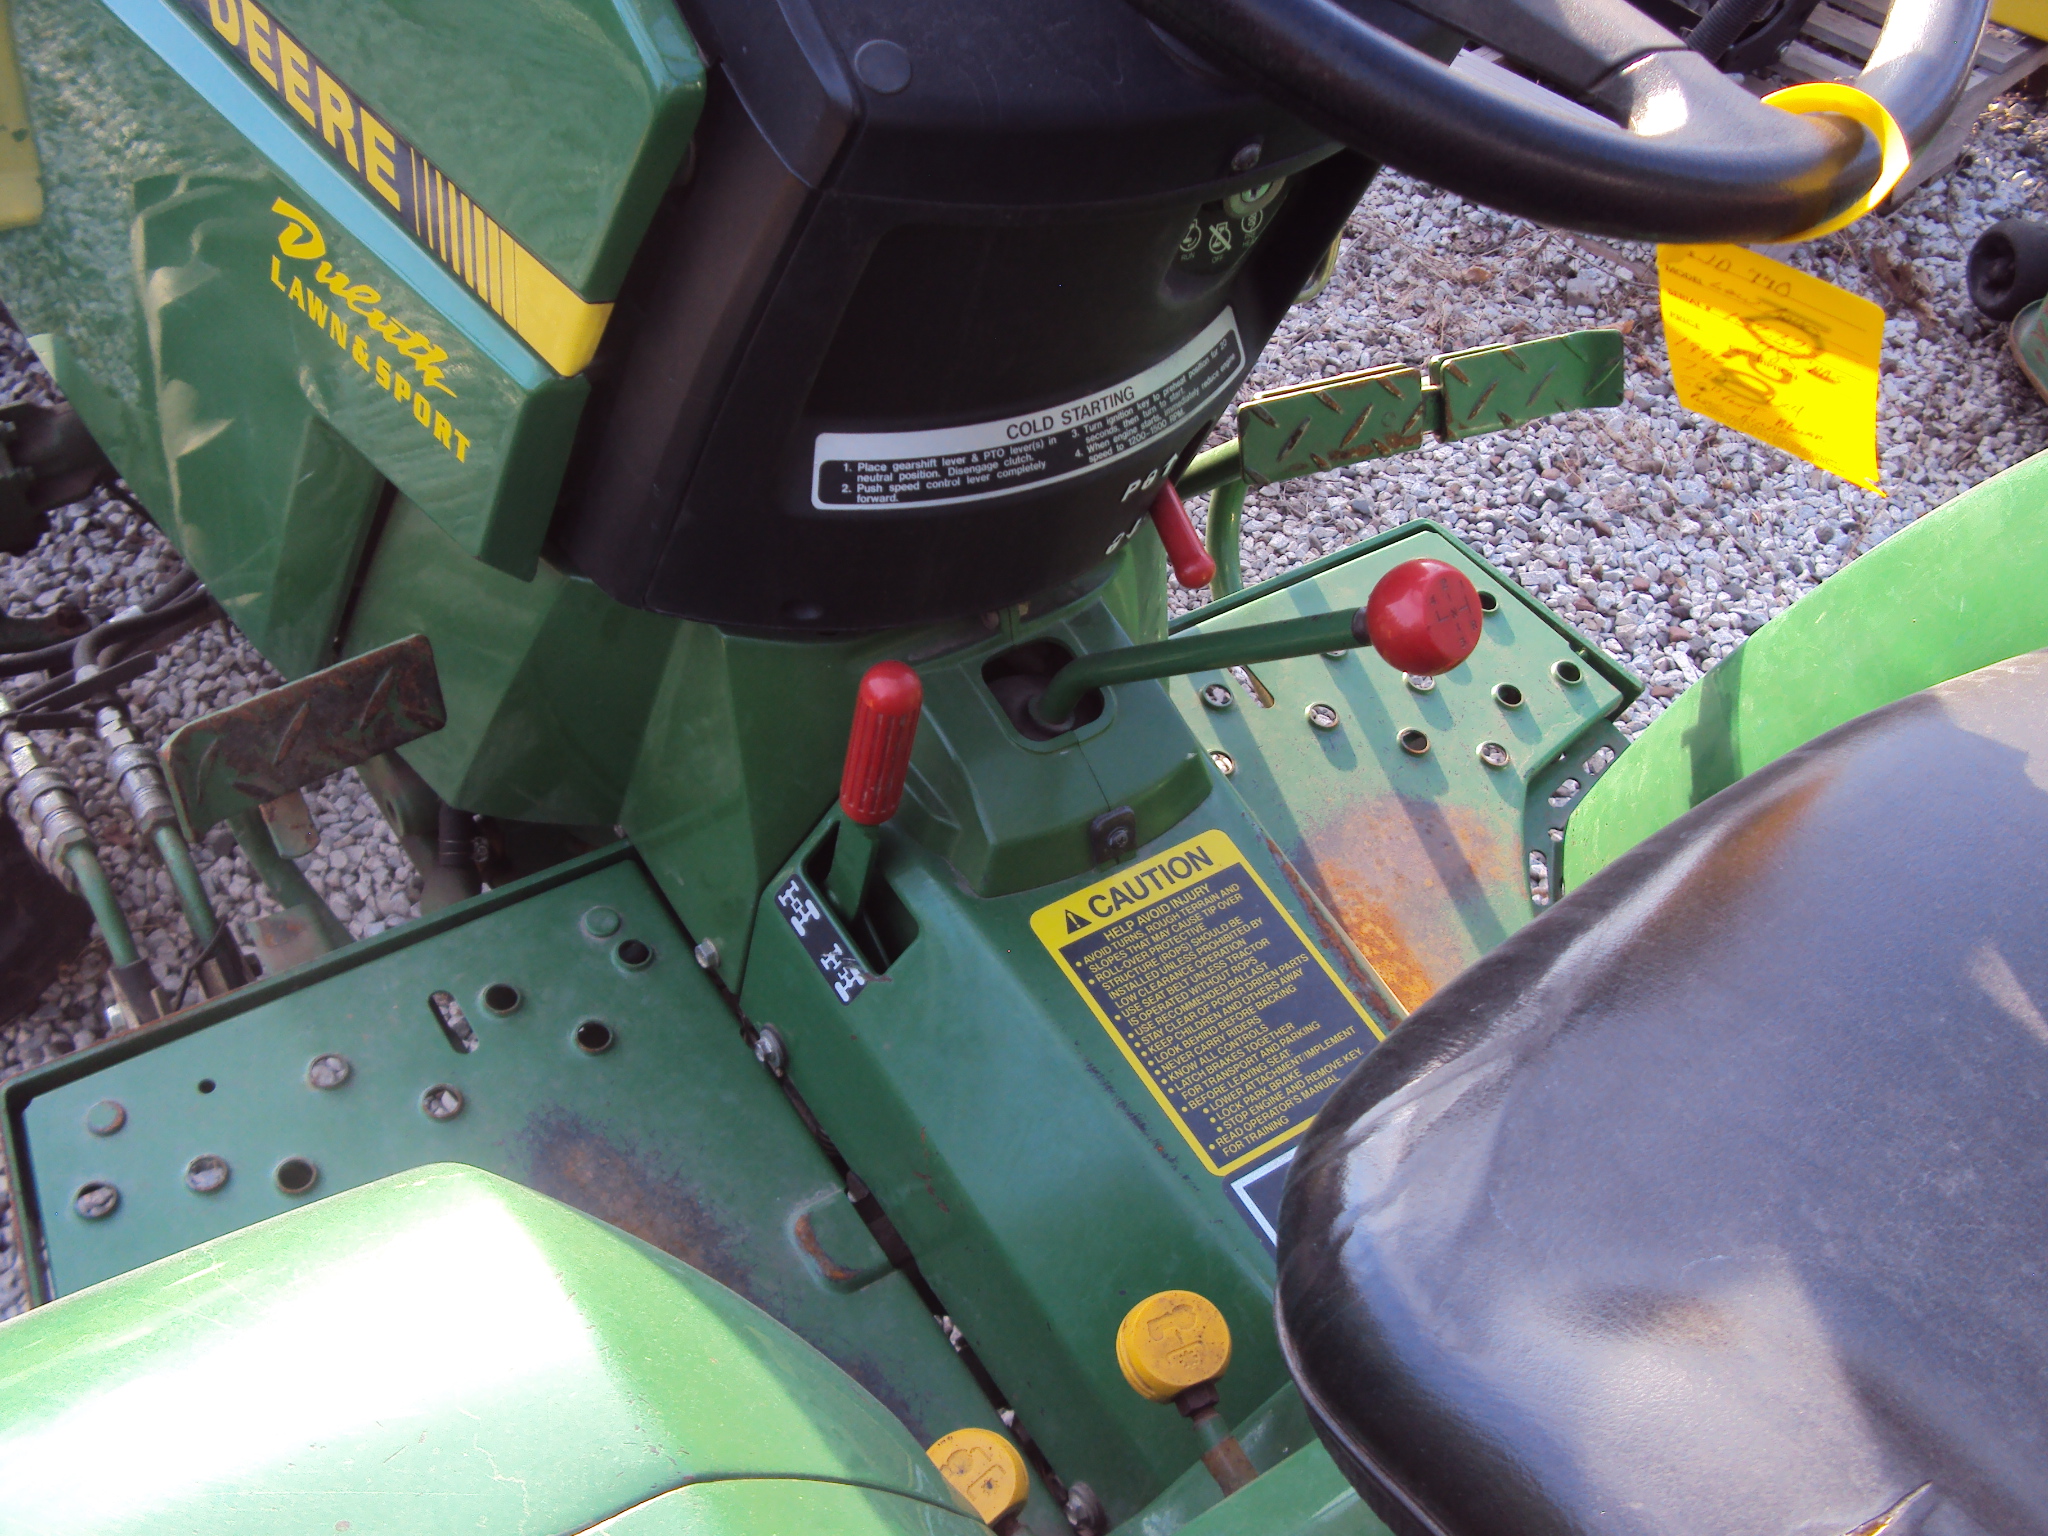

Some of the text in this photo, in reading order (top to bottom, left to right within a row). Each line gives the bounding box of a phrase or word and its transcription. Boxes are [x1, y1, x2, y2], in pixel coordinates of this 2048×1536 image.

[1180, 251, 1196, 261] RUN
[1211, 254, 1224, 264] OFF
[271, 197, 457, 398] Duluth
[1006, 385, 1136, 441] COLD STARTING
[1071, 428, 1080, 438] 3.
[1083, 420, 1103, 434] Turn
[1105, 407, 1134, 429] ignition
[1136, 397, 1150, 411] key
[1152, 392, 1161, 402] to
[1162, 375, 1187, 397] preheat
[1188, 356, 1210, 379] position
[1210, 347, 1219, 359] for
[1074, 448, 1084, 458] 4.
[1087, 438, 1111, 453] When
[1113, 425, 1138, 445] engine
[1164, 386, 1200, 416] immediately
[1201, 369, 1220, 389] reduce
[1123, 417, 1140, 432] then
[1142, 407, 1157, 420] turn
[1159, 401, 1167, 411] to
[841, 459, 1047, 494] 2. Push speed control lever completely
[843, 437, 1058, 473] 1. Place gearshift lever & PTO lever(s) in
[857, 472, 893, 483] neutral
[948, 461, 999, 477] Disengage
[1088, 449, 1113, 464] speed
[1115, 442, 1124, 452] to
[857, 493, 899, 504] forward.
[1088, 845, 1214, 918] CAUTION
[1104, 881, 1210, 941] HELP AVOID INJURY
[1083, 882, 1239, 964] AVOID TURNS, ROUGH TERRAIN AND
[1090, 892, 1242, 973] SLOPES THAT MAY CAUSE TIP OVER
[1096, 922, 1205, 982] ROLL-OVER PROTECTIVE
[1103, 915, 1241, 990] STRUCTURE (ROPS) SHOULD BE
[1109, 917, 1263, 999] INSTALLED UNLESS PROHIBITED BY
[1116, 937, 1246, 1008] LOW CLEARANCE OPERATION
[1122, 937, 1269, 1017] USE SEAT BELT UNLESS TRACTOR
[1129, 955, 1257, 1026] IS OPERATED WITHOUT ROPS
[1135, 962, 1268, 1035] USE RECOMMENDED BALLAST
[1142, 953, 1309, 1045] STAY CLEAR OF POWER DRIVEN PARTS
[1149, 968, 1304, 1054] KEEP CHILDREN AND OTHERS AWAY
[1155, 984, 1296, 1063] LOOK BEHIND BEFORE BACKING
[1162, 1014, 1261, 1072] NEVER CARRY RIDERS
[1168, 1023, 1268, 1081] KNOW ALL CONTROLS
[1175, 1022, 1294, 1090] LATCH BRAKES TOGETHER
[1182, 1020, 1320, 1099] FOR TRANSPORT AND PARKING
[1189, 1047, 1293, 1109] BEFORE LEAVING SEAT:
[1210, 1026, 1357, 1110] LOWER ATTACHMENT/IMPLEMENT
[1216, 1074, 1340, 1146] READ OPERATOR'S MANUAL
[1217, 1068, 1301, 1120] LOCK PARK BRAKE
[1224, 1047, 1364, 1129] STOP ENGINE AND REMOVE KEY.
[1223, 1114, 1288, 1156] FOR TRAINING
